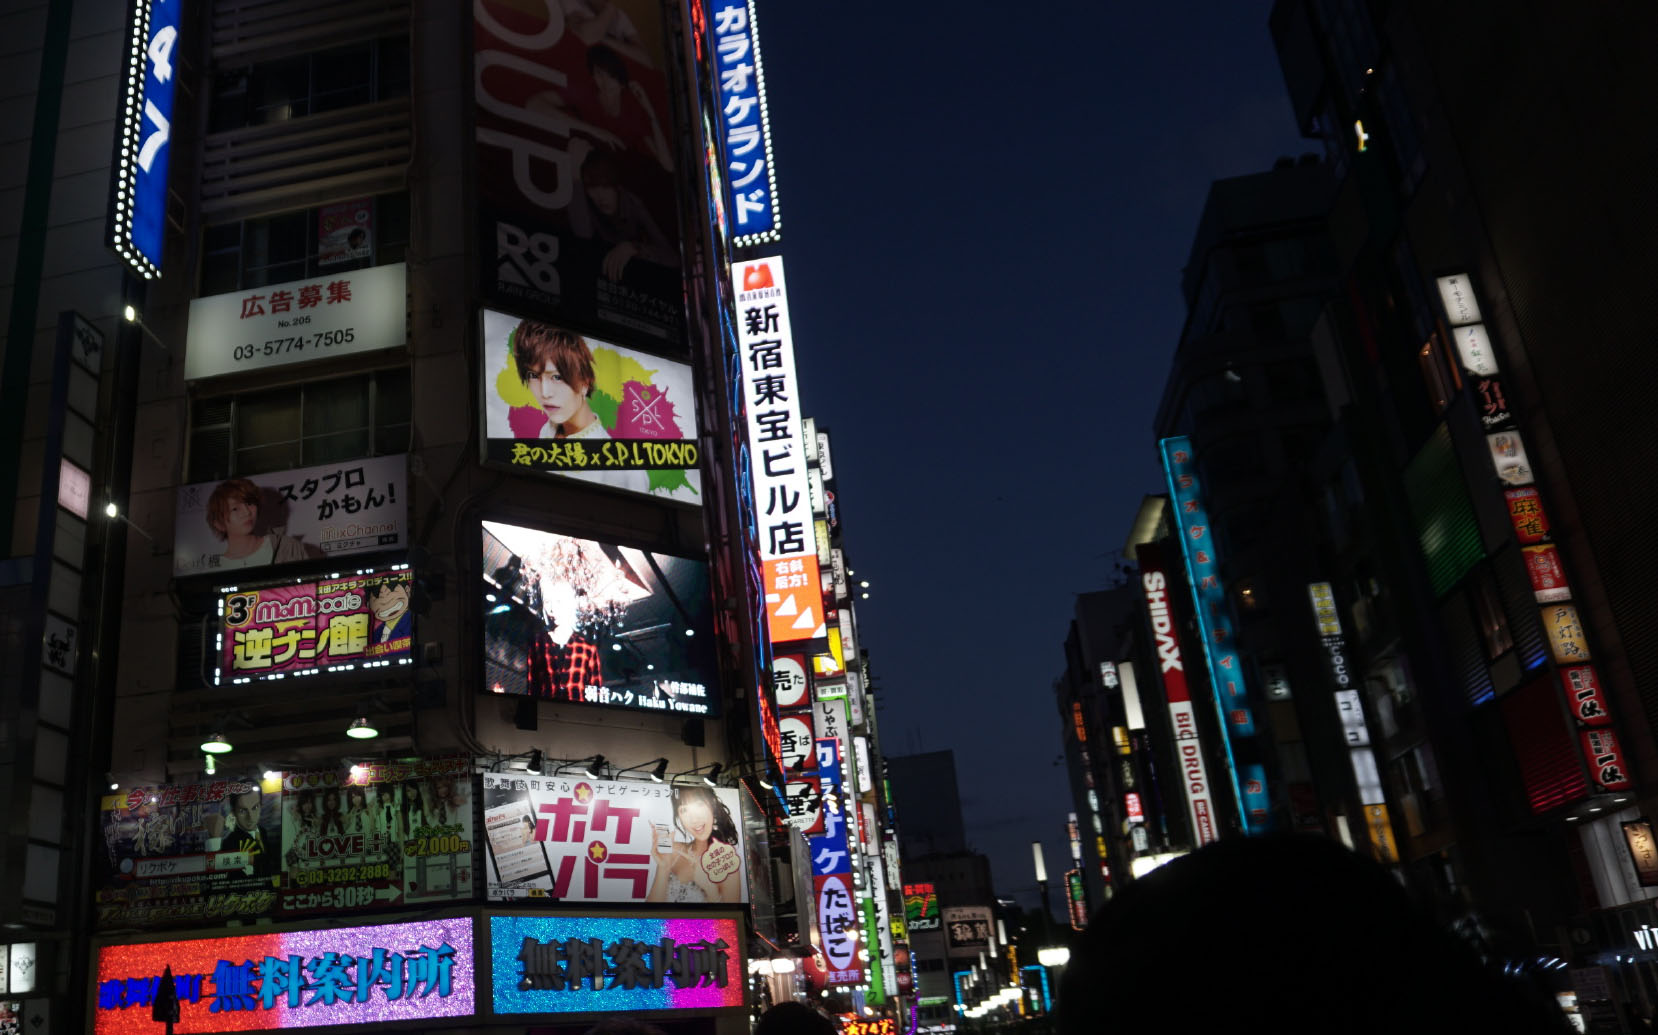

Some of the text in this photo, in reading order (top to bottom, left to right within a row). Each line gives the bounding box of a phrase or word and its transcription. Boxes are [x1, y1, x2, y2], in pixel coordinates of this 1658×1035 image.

[714, 4, 767, 226] カラオケランド
[239, 280, 353, 319] 広告募集
[233, 329, 355, 361] 03-5774-7505
[745, 304, 805, 556] 新宿東宝ビル店
[511, 442, 588, 467] 君の太陽
[642, 442, 698, 466] TOKYO
[278, 467, 365, 505] スタプロ
[317, 483, 396, 520] かもん!
[1512, 498, 1545, 536] 麻雀
[232, 613, 369, 671] 逆ナン館
[1143, 571, 1184, 674] SHIDAX
[484, 778, 570, 794] 歌舞伎町安心
[1182, 744, 1205, 795] DRUG
[282, 884, 376, 910] ここから30秒
[823, 887, 855, 959] たばこ
[99, 941, 456, 1013] 歌舞町 無料案内所
[519, 937, 729, 992] 無料案内所
